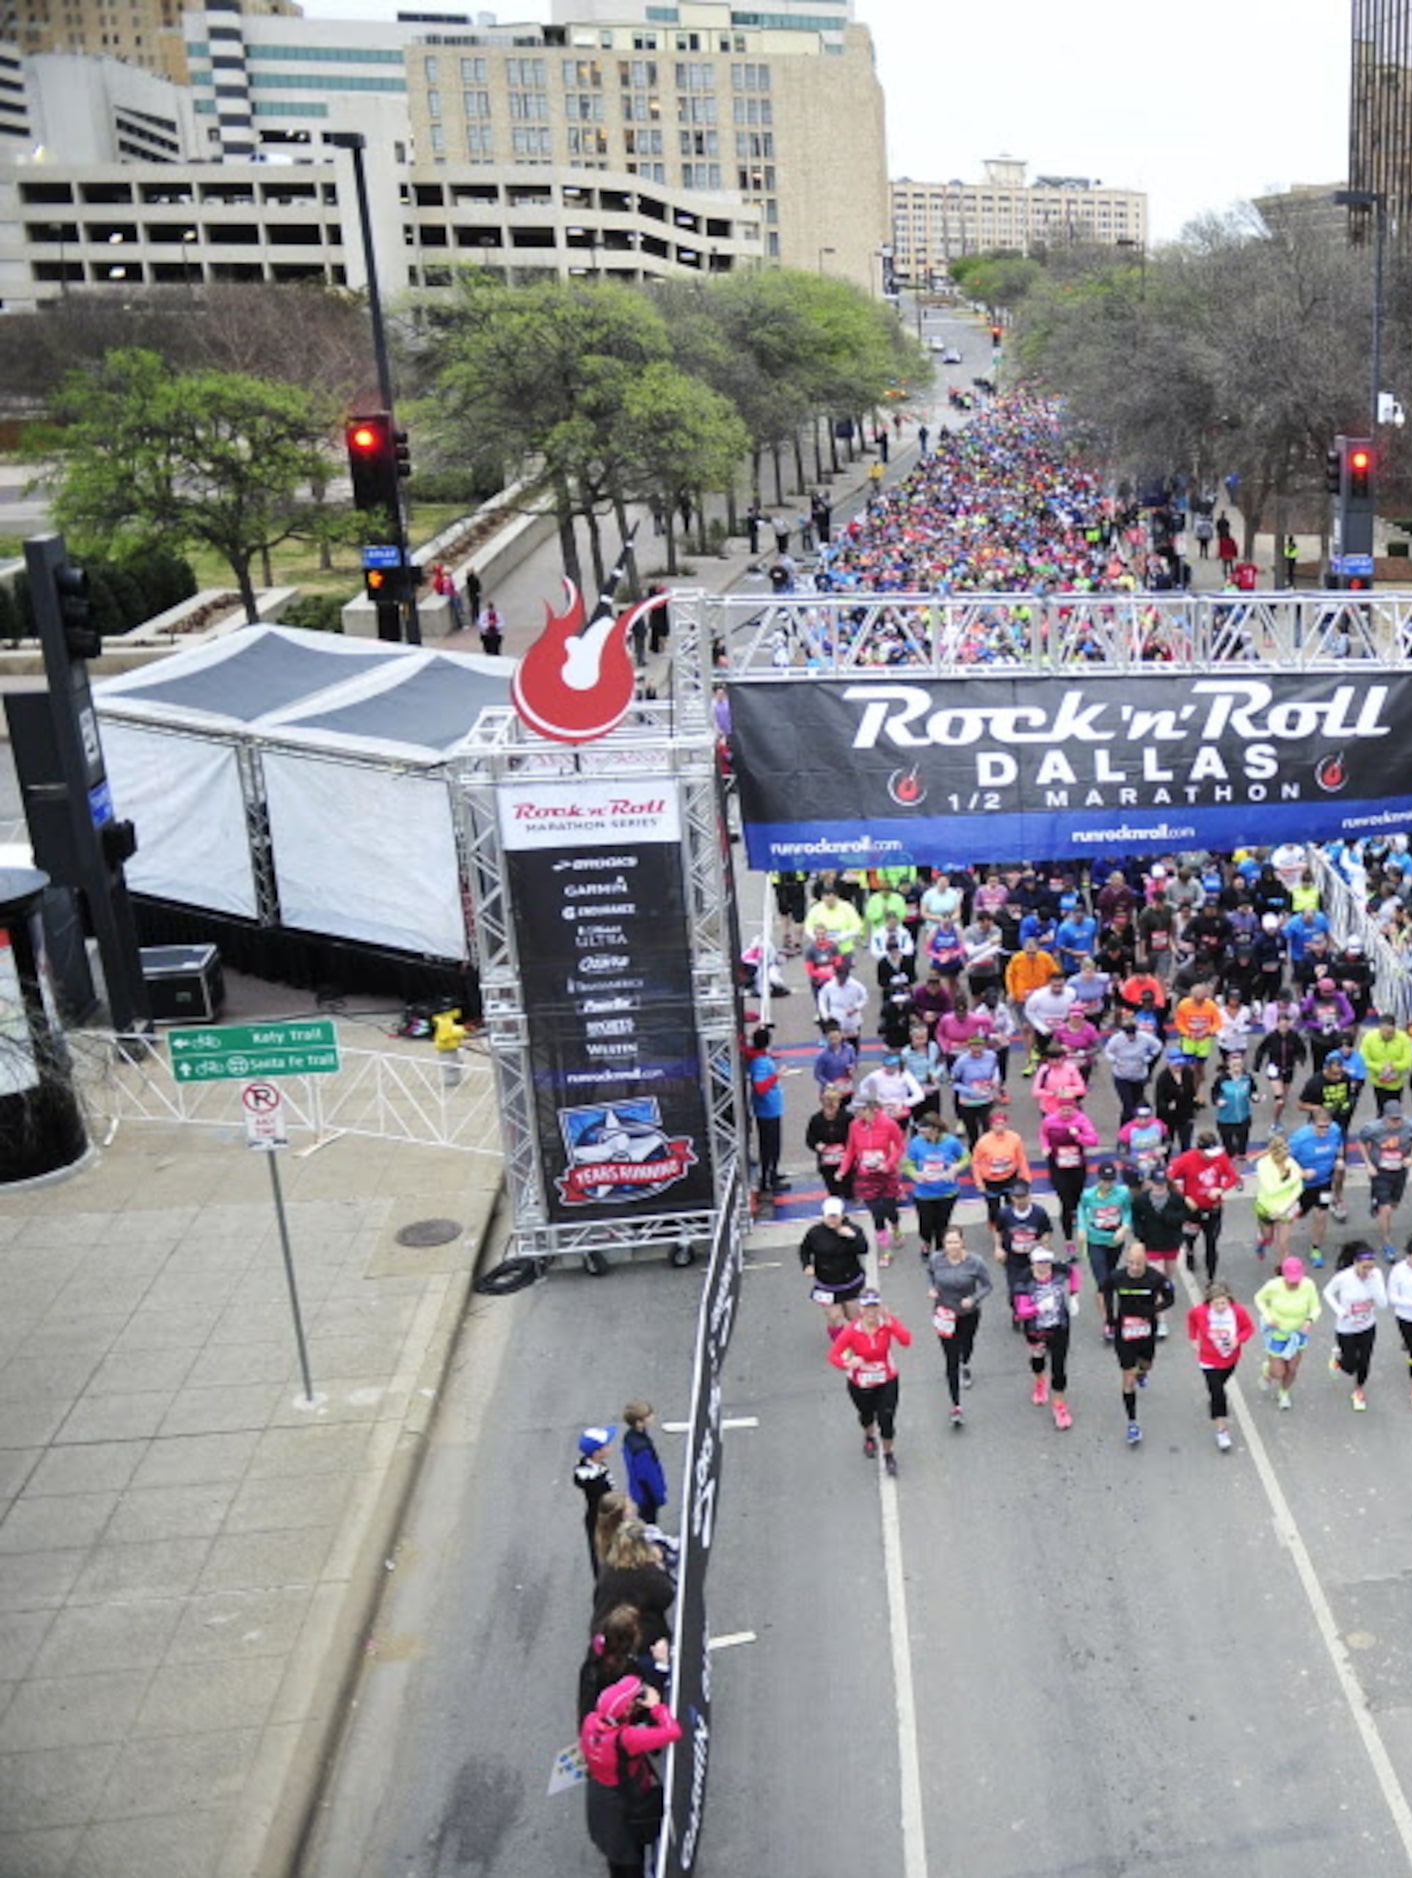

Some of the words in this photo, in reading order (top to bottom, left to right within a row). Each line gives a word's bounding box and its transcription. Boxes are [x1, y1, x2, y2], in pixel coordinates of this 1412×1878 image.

[843, 685, 1116, 748] Rock
[1121, 704, 1197, 740] 'n'
[1190, 680, 1391, 739] Roll
[976, 743, 1279, 787] DALLAS
[948, 792, 1001, 811] 1/2
[1045, 783, 1300, 807] MARATHON
[512, 803, 586, 820] Rock
[609, 799, 666, 815] Roll
[525, 820, 605, 833] MARATHON
[611, 817, 658, 829] SERIES
[1072, 823, 1195, 843] runrocknroll.com
[770, 835, 901, 856] runrocknroll.com
[564, 882, 628, 897] GARMIN
[252, 1032, 285, 1044] Katy
[289, 1027, 323, 1042] Trail
[250, 1057, 285, 1071] Santa
[289, 1055, 304, 1067] Fe
[307, 1053, 335, 1066] Trail
